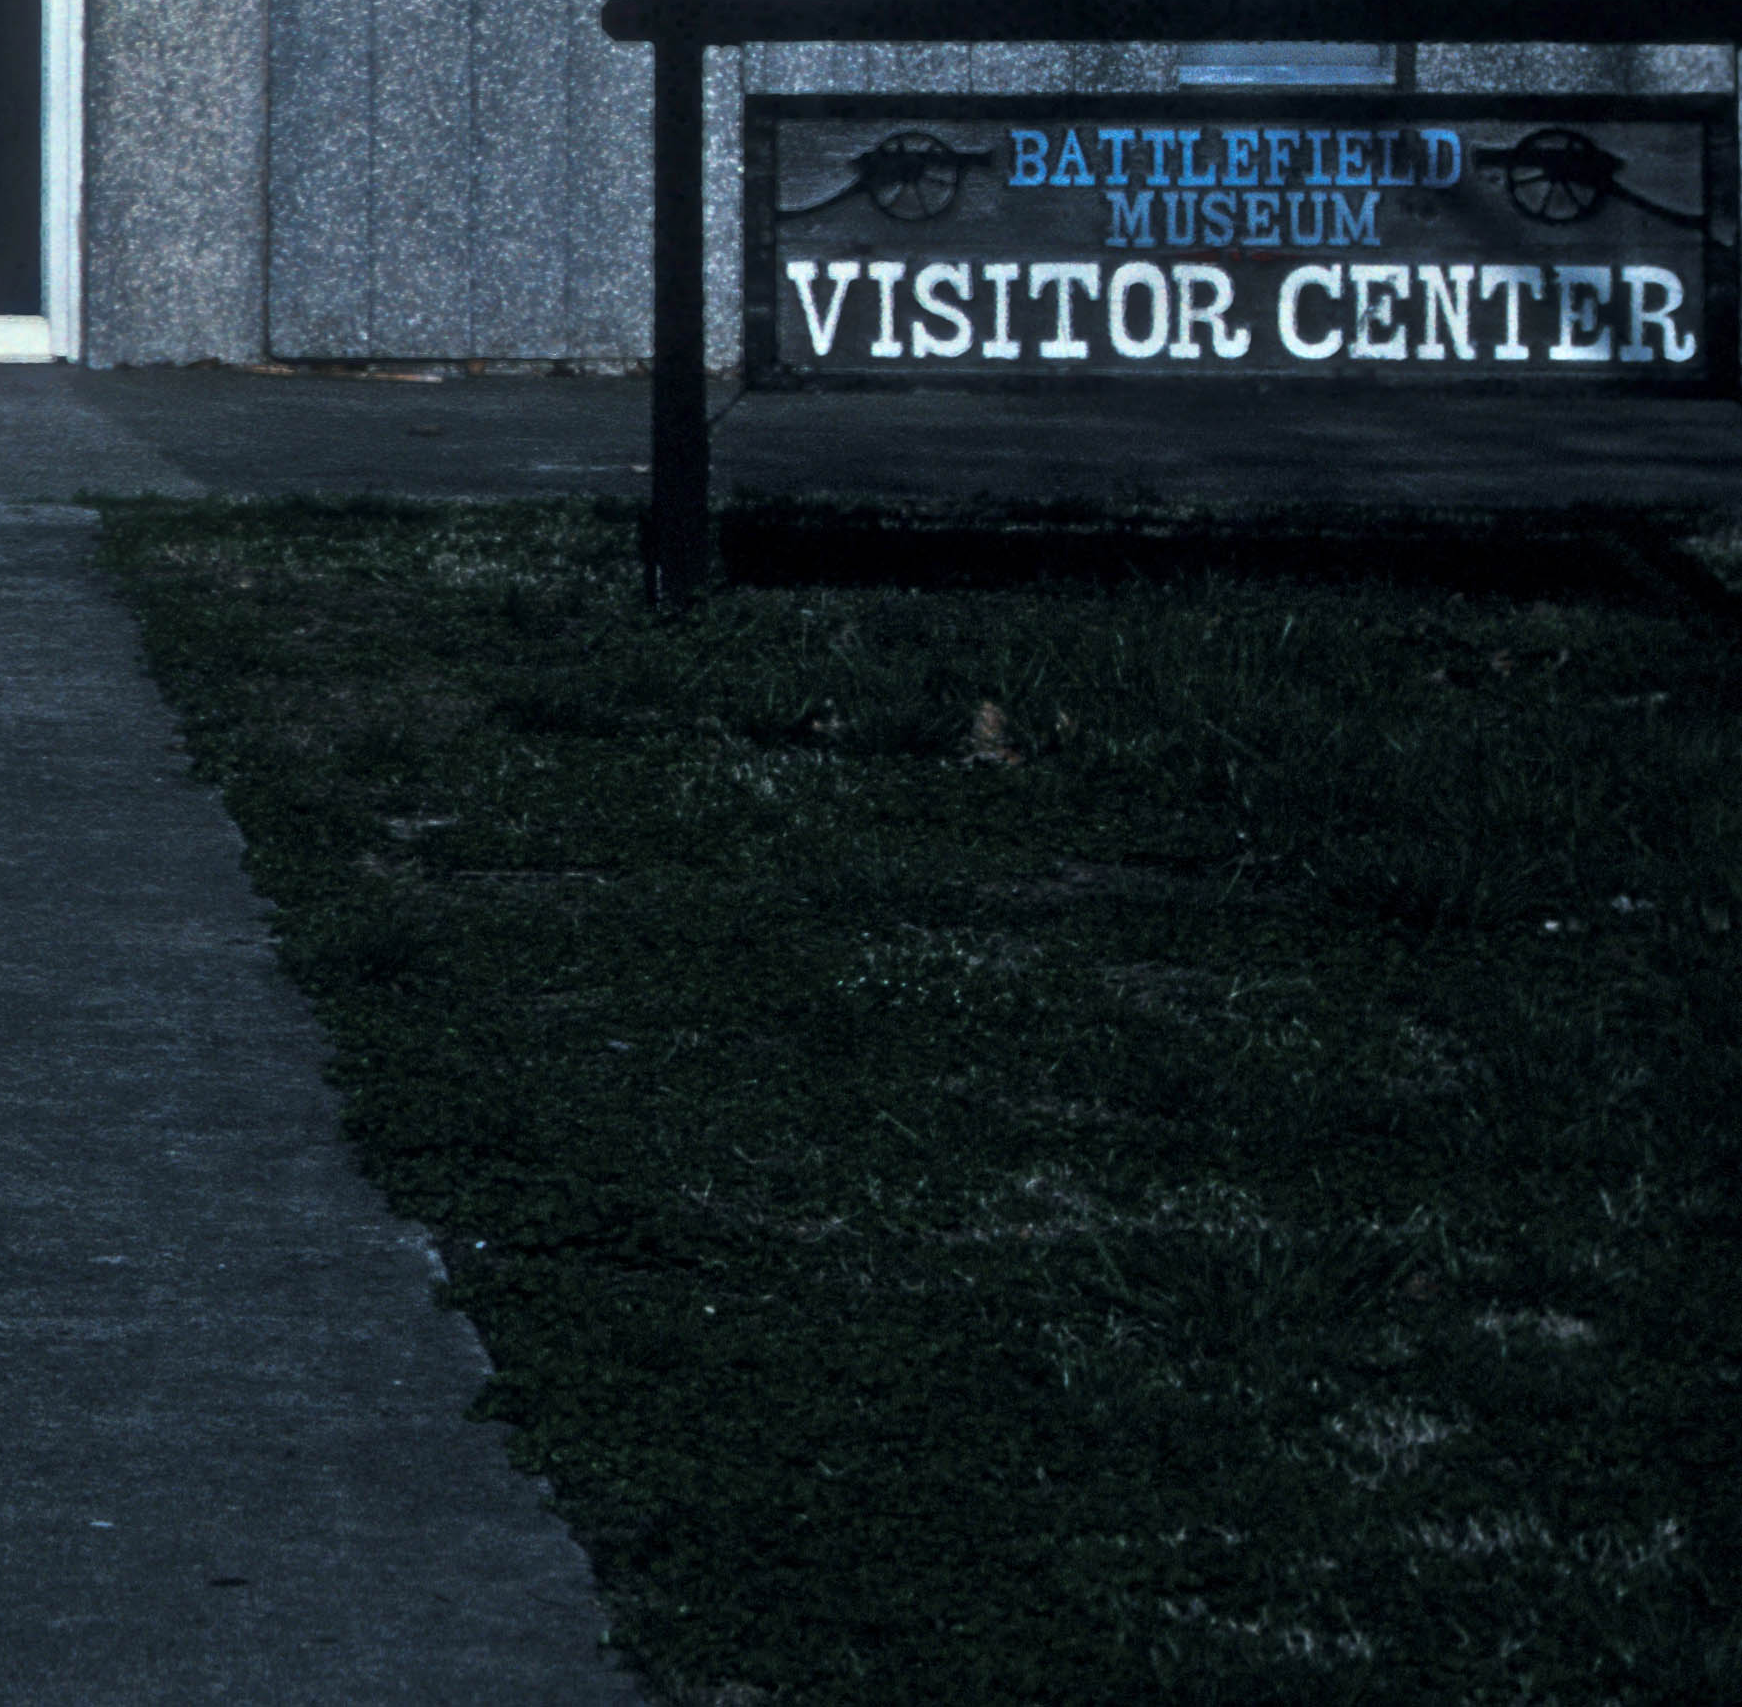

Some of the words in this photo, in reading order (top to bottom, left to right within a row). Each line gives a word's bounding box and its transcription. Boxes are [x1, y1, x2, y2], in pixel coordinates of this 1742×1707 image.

[1009, 129, 1462, 188] BATTLEFIELD
[1104, 191, 1381, 247] MUSEUM
[785, 260, 1252, 359] VISITOR
[1276, 263, 1697, 363] CENTER
